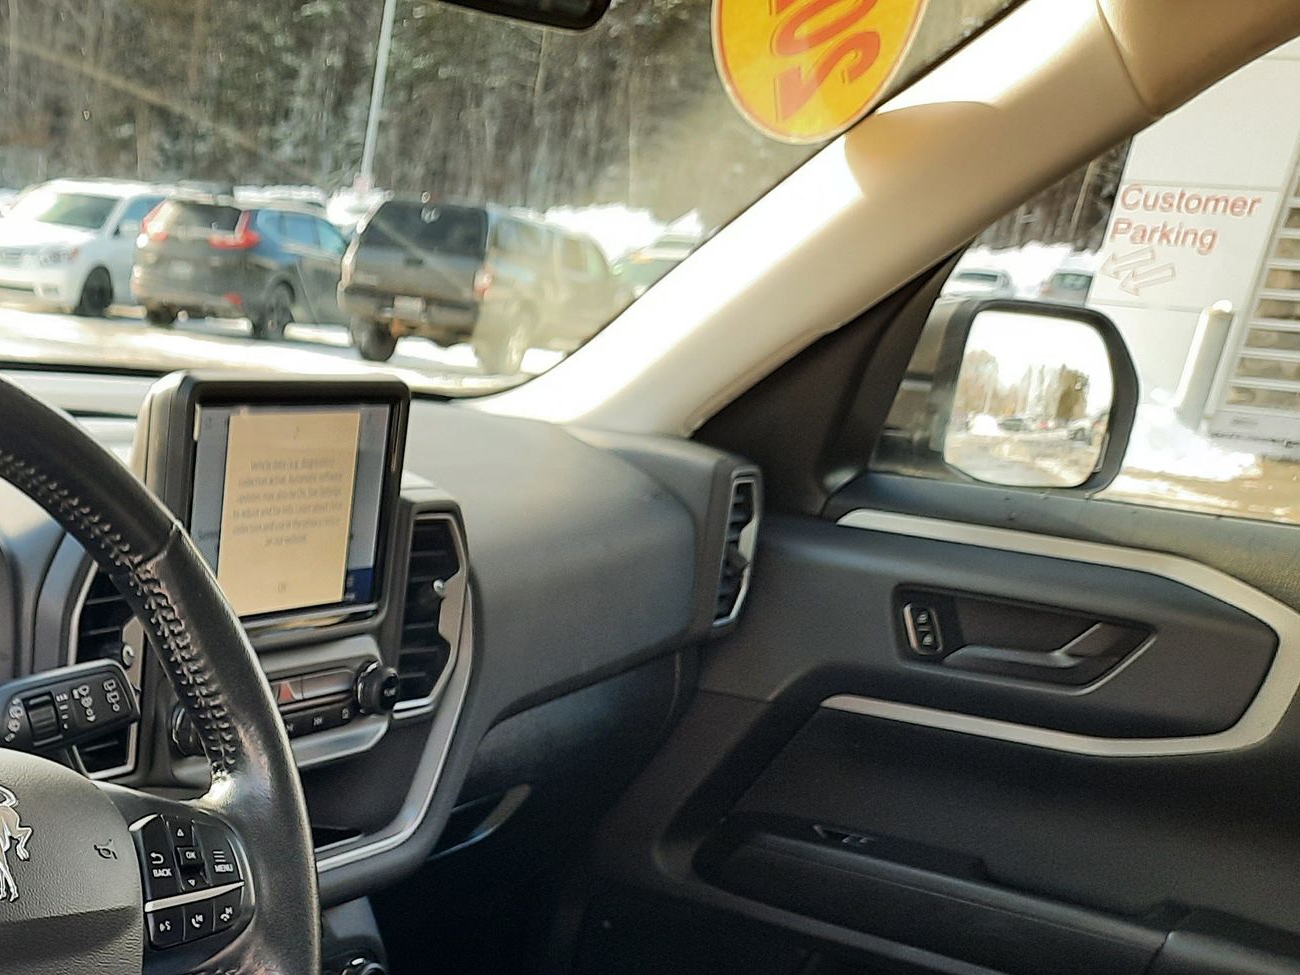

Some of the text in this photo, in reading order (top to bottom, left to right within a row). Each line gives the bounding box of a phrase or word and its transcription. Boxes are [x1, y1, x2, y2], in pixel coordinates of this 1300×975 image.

[1120, 183, 1262, 217] Customer
[1110, 217, 1219, 256] Parking
[152, 868, 173, 878] BACK
[214, 863, 234, 873] MENU
